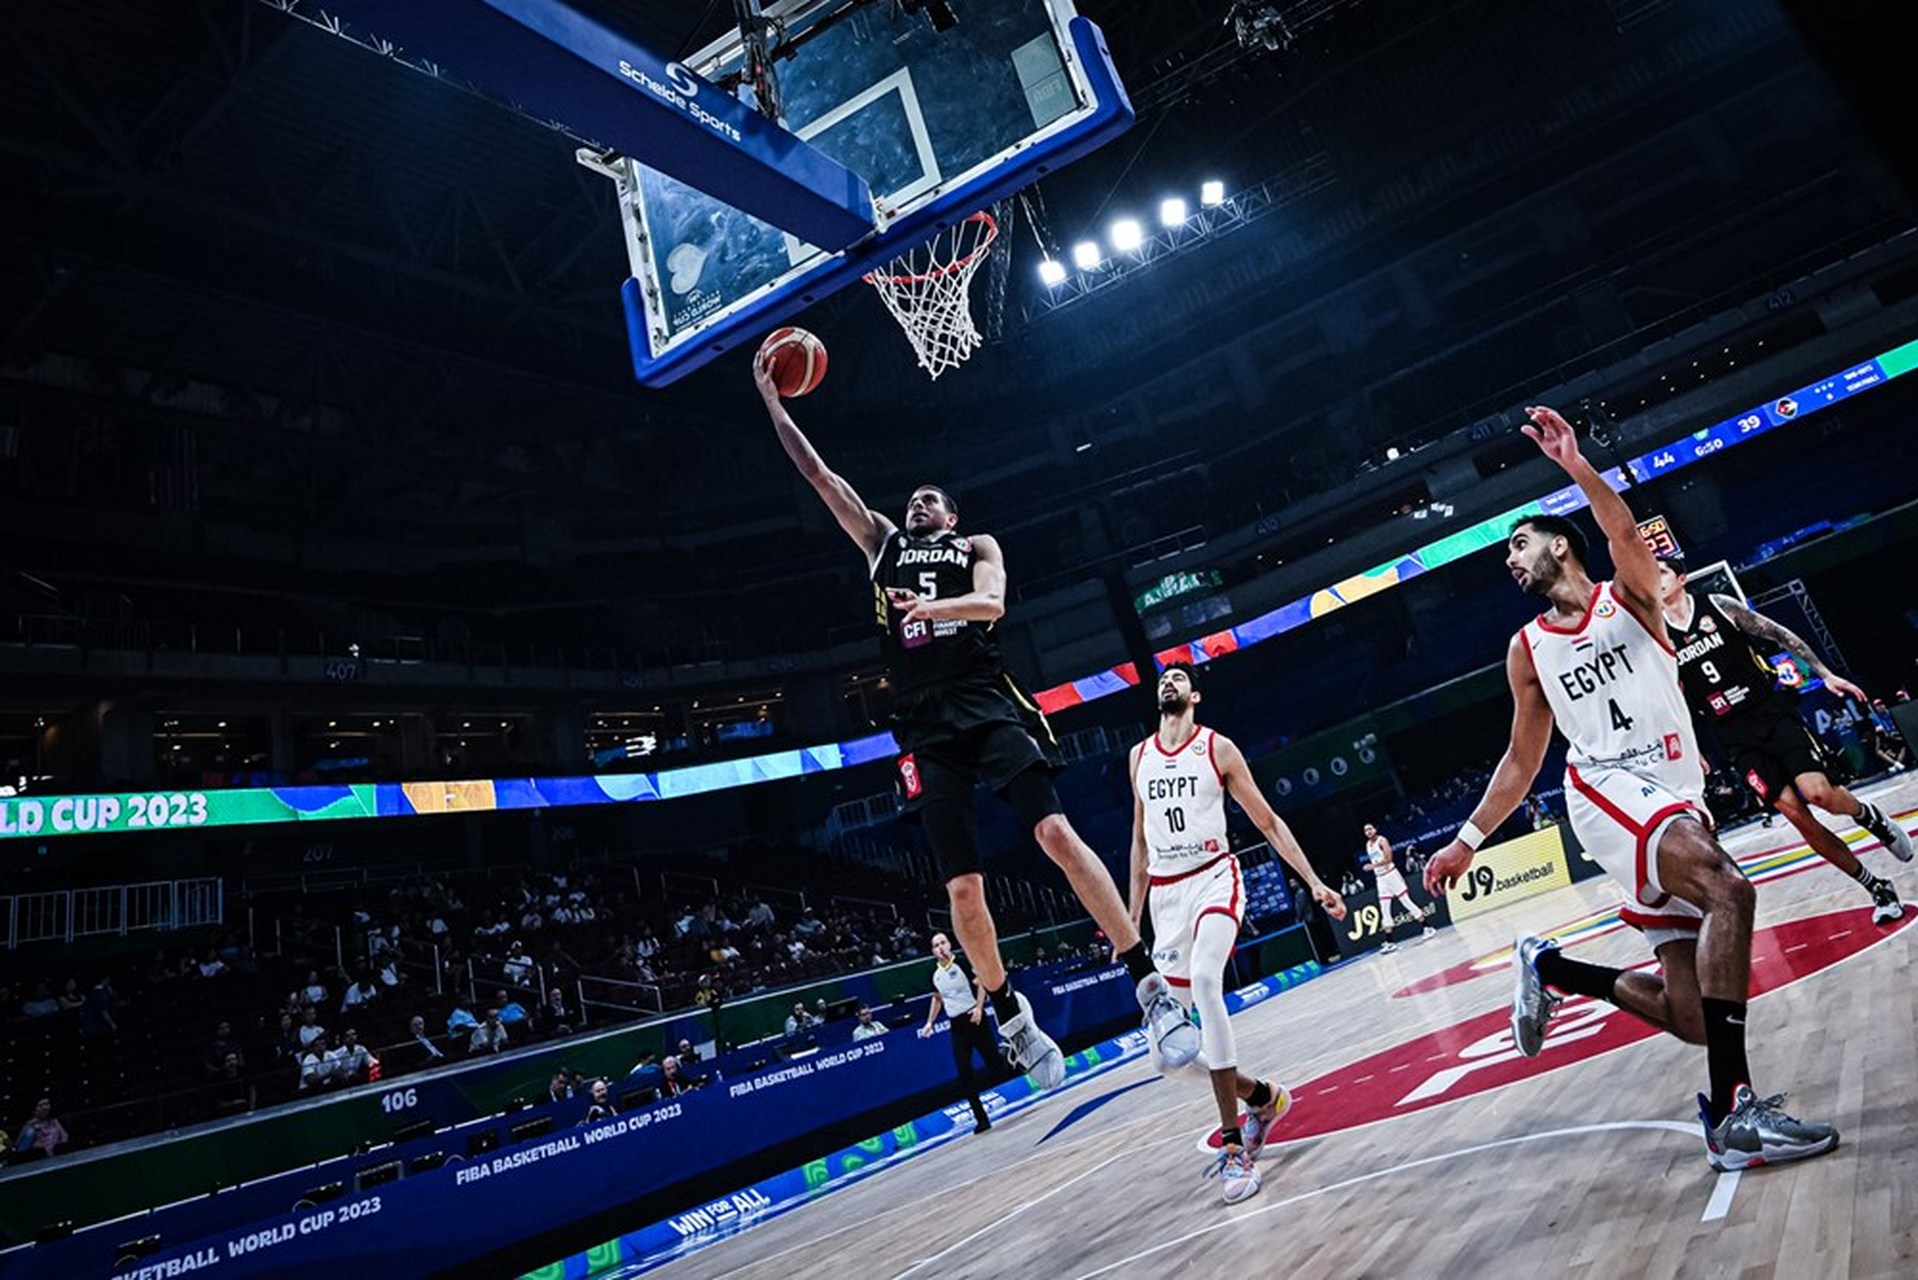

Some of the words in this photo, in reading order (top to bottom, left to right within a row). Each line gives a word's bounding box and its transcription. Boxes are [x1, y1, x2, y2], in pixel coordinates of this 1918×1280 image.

[619, 60, 686, 110] Schelde
[689, 101, 741, 141] Sports
[1737, 415, 1761, 433] 39
[1653, 451, 1676, 468] 44
[1694, 438, 1724, 457] 6:50
[896, 549, 969, 569] JORDAN
[918, 572, 937, 600] 5
[903, 621, 926, 640] CFI
[1676, 632, 1725, 666] JORDAN
[326, 661, 356, 680] 407
[1559, 643, 1634, 702] EGYPT
[1700, 660, 1721, 684] 9
[1608, 698, 1634, 731] 4
[1149, 776, 1198, 800] EGYPT
[52, 797, 120, 832] CUP
[128, 793, 208, 827] 2023
[1165, 806, 1186, 833] 10
[303, 842, 333, 862] 207
[729, 1080, 754, 1098] FIBA
[754, 1062, 815, 1091] BASKETBALL
[816, 1052, 846, 1072] WORLD
[847, 1046, 863, 1062] CUP
[863, 1041, 885, 1057] 2023
[382, 1088, 417, 1112] 106
[456, 1163, 490, 1185] FIBA
[492, 1136, 580, 1174] BASKETBALL
[584, 1121, 627, 1145] WORLD
[629, 1114, 652, 1133] CUP
[653, 1103, 682, 1123] 2023
[668, 1207, 715, 1236] WIN
[705, 1200, 733, 1216] FOR
[731, 1188, 771, 1213] ALL
[228, 1223, 296, 1258] WORLD
[299, 1211, 335, 1235] CUP
[338, 1197, 382, 1223] 2023
